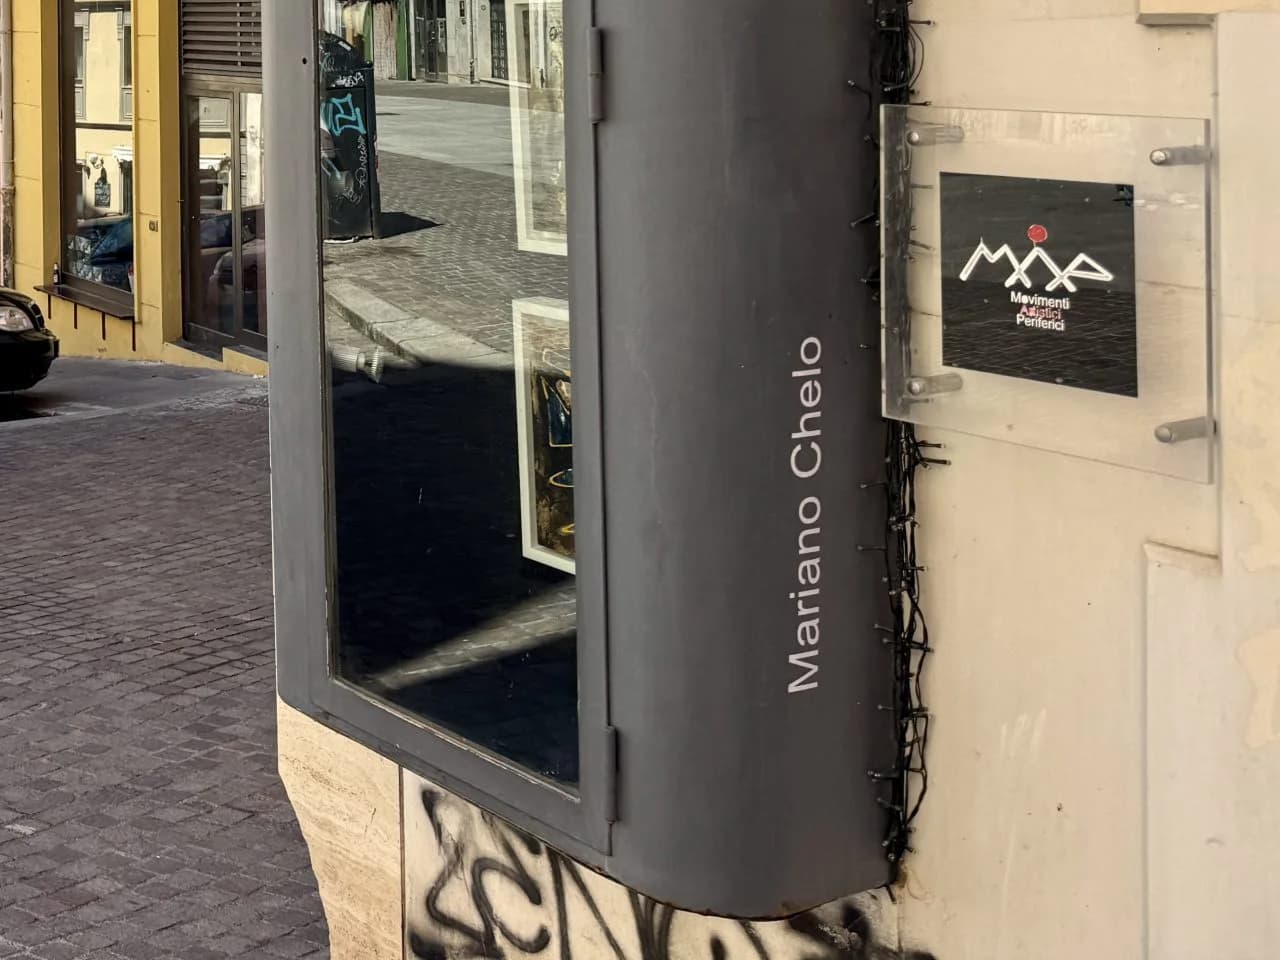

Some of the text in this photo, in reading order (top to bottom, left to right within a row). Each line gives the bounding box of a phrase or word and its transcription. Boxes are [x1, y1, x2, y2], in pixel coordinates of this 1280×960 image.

[1010, 290, 1071, 310] Movimenti
[1019, 304, 1062, 320] Artistici
[1016, 313, 1065, 331] Periferici
[787, 335, 823, 694] Mariano Chelo
